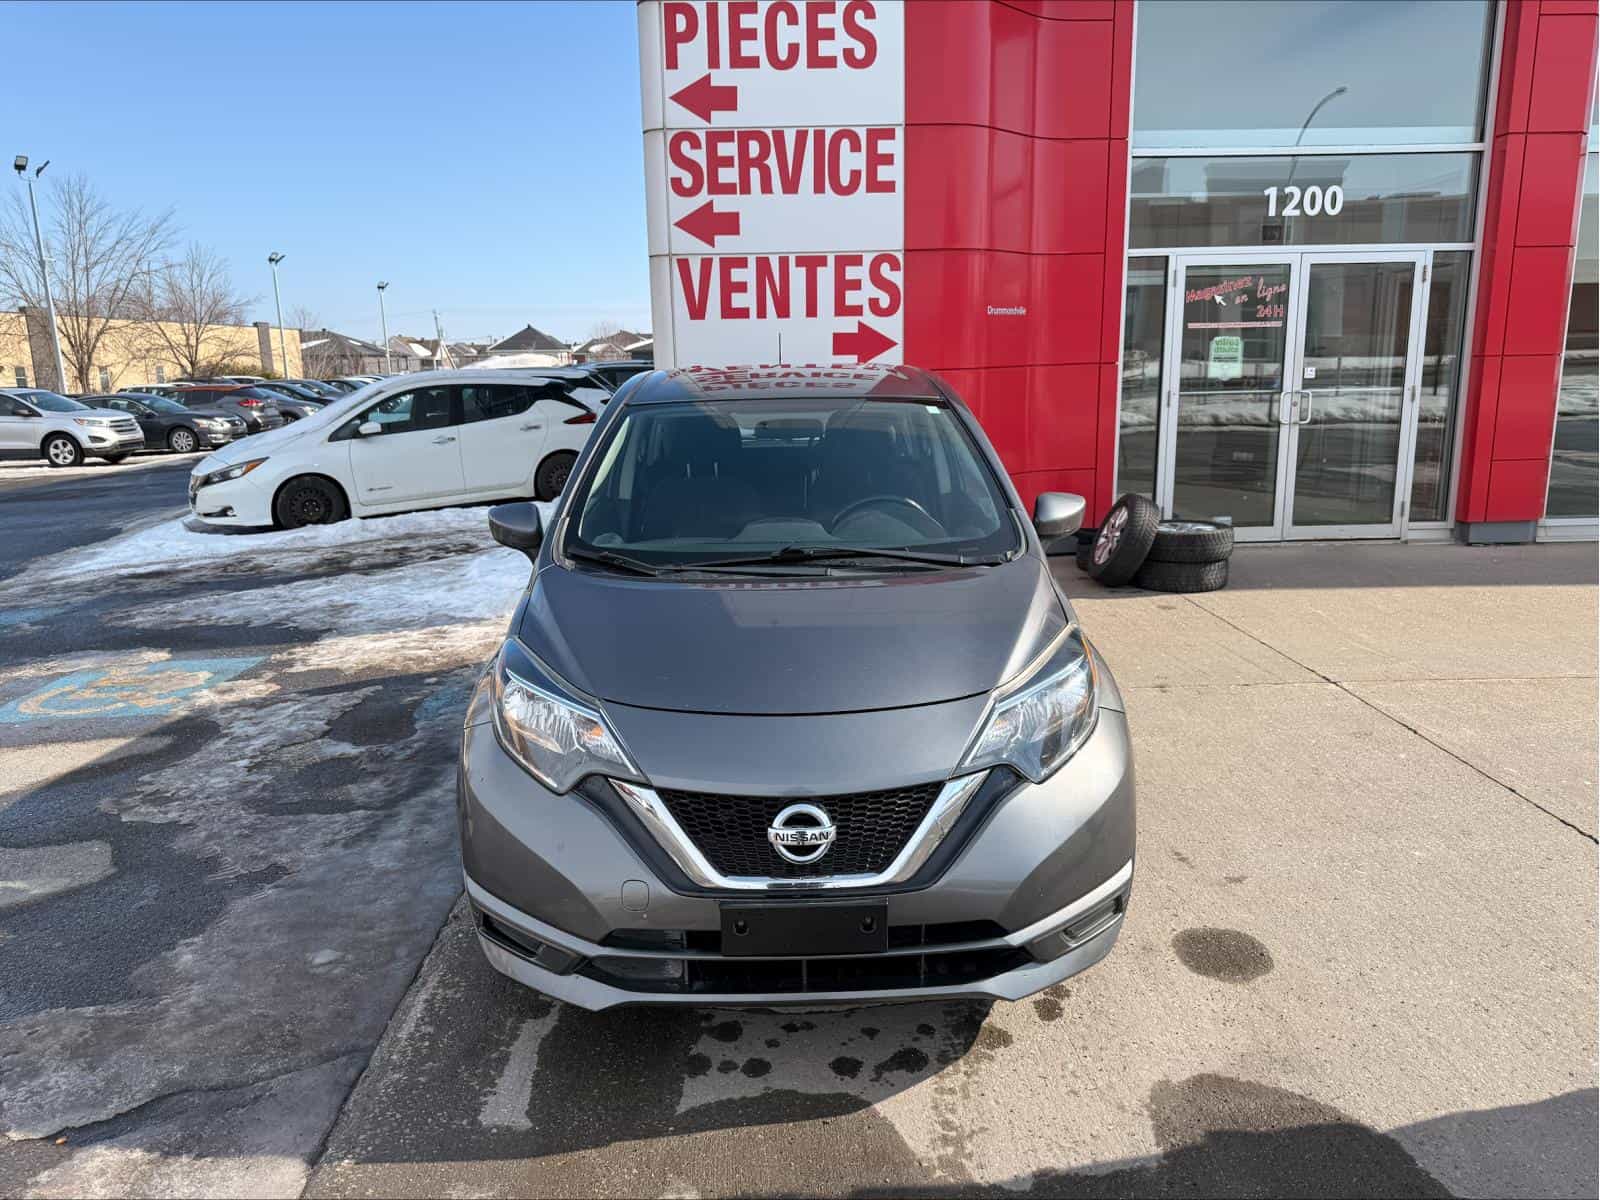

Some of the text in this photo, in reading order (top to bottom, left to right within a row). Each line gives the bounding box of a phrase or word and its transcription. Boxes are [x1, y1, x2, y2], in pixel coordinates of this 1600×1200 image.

[664, 1, 877, 70] PIECES
[669, 128, 896, 198] SERVICE
[1264, 185, 1343, 217] 1200
[676, 253, 901, 321] VENTES
[775, 831, 829, 842] NISSAN
